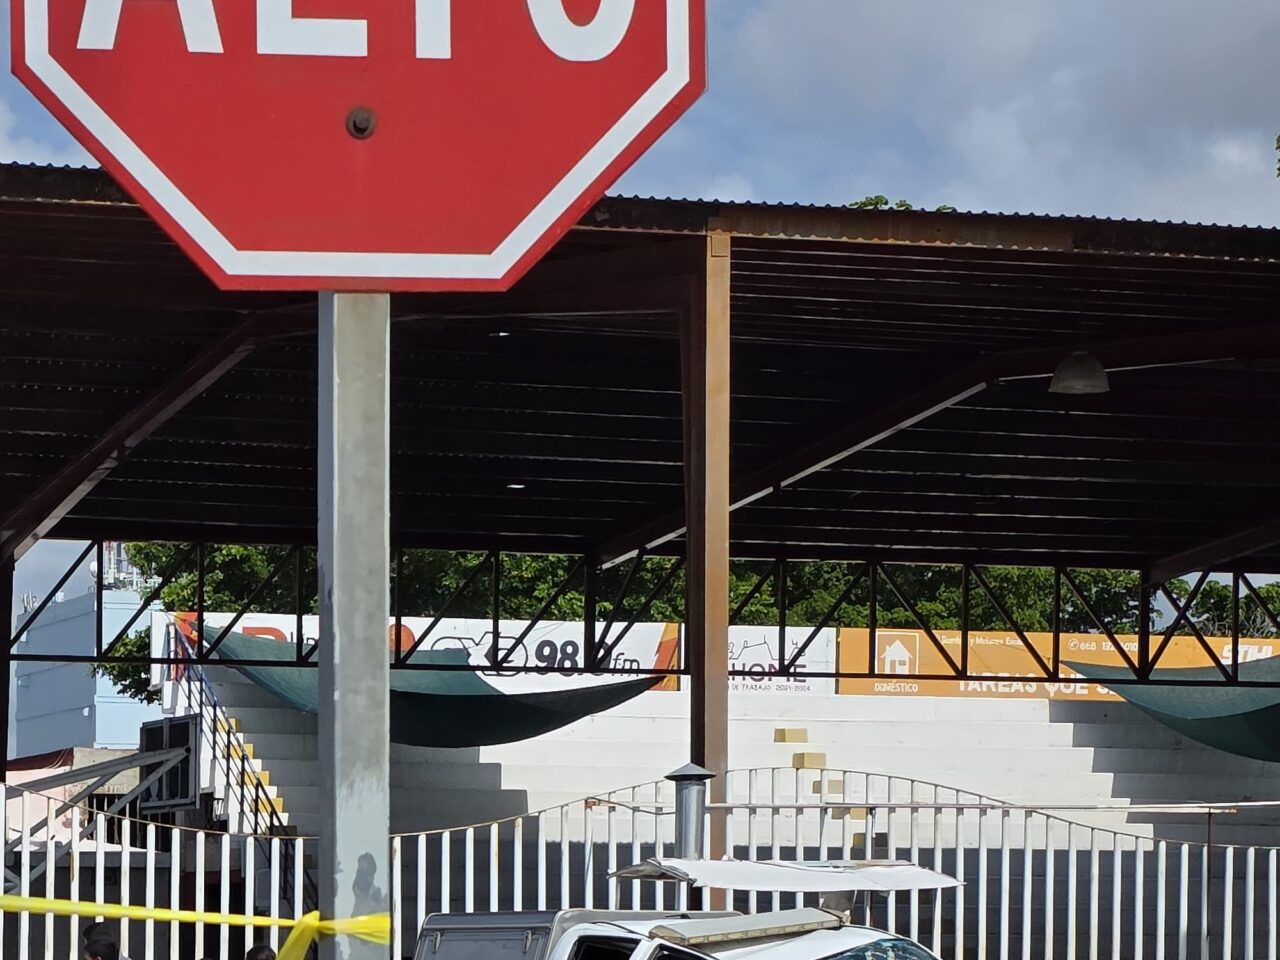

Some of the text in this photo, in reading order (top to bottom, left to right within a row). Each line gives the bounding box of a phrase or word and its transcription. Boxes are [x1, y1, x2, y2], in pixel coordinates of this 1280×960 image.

[612, 652, 640, 677] fm
[727, 663, 807, 683] HOME
[959, 672, 1037, 693] TAREAS
